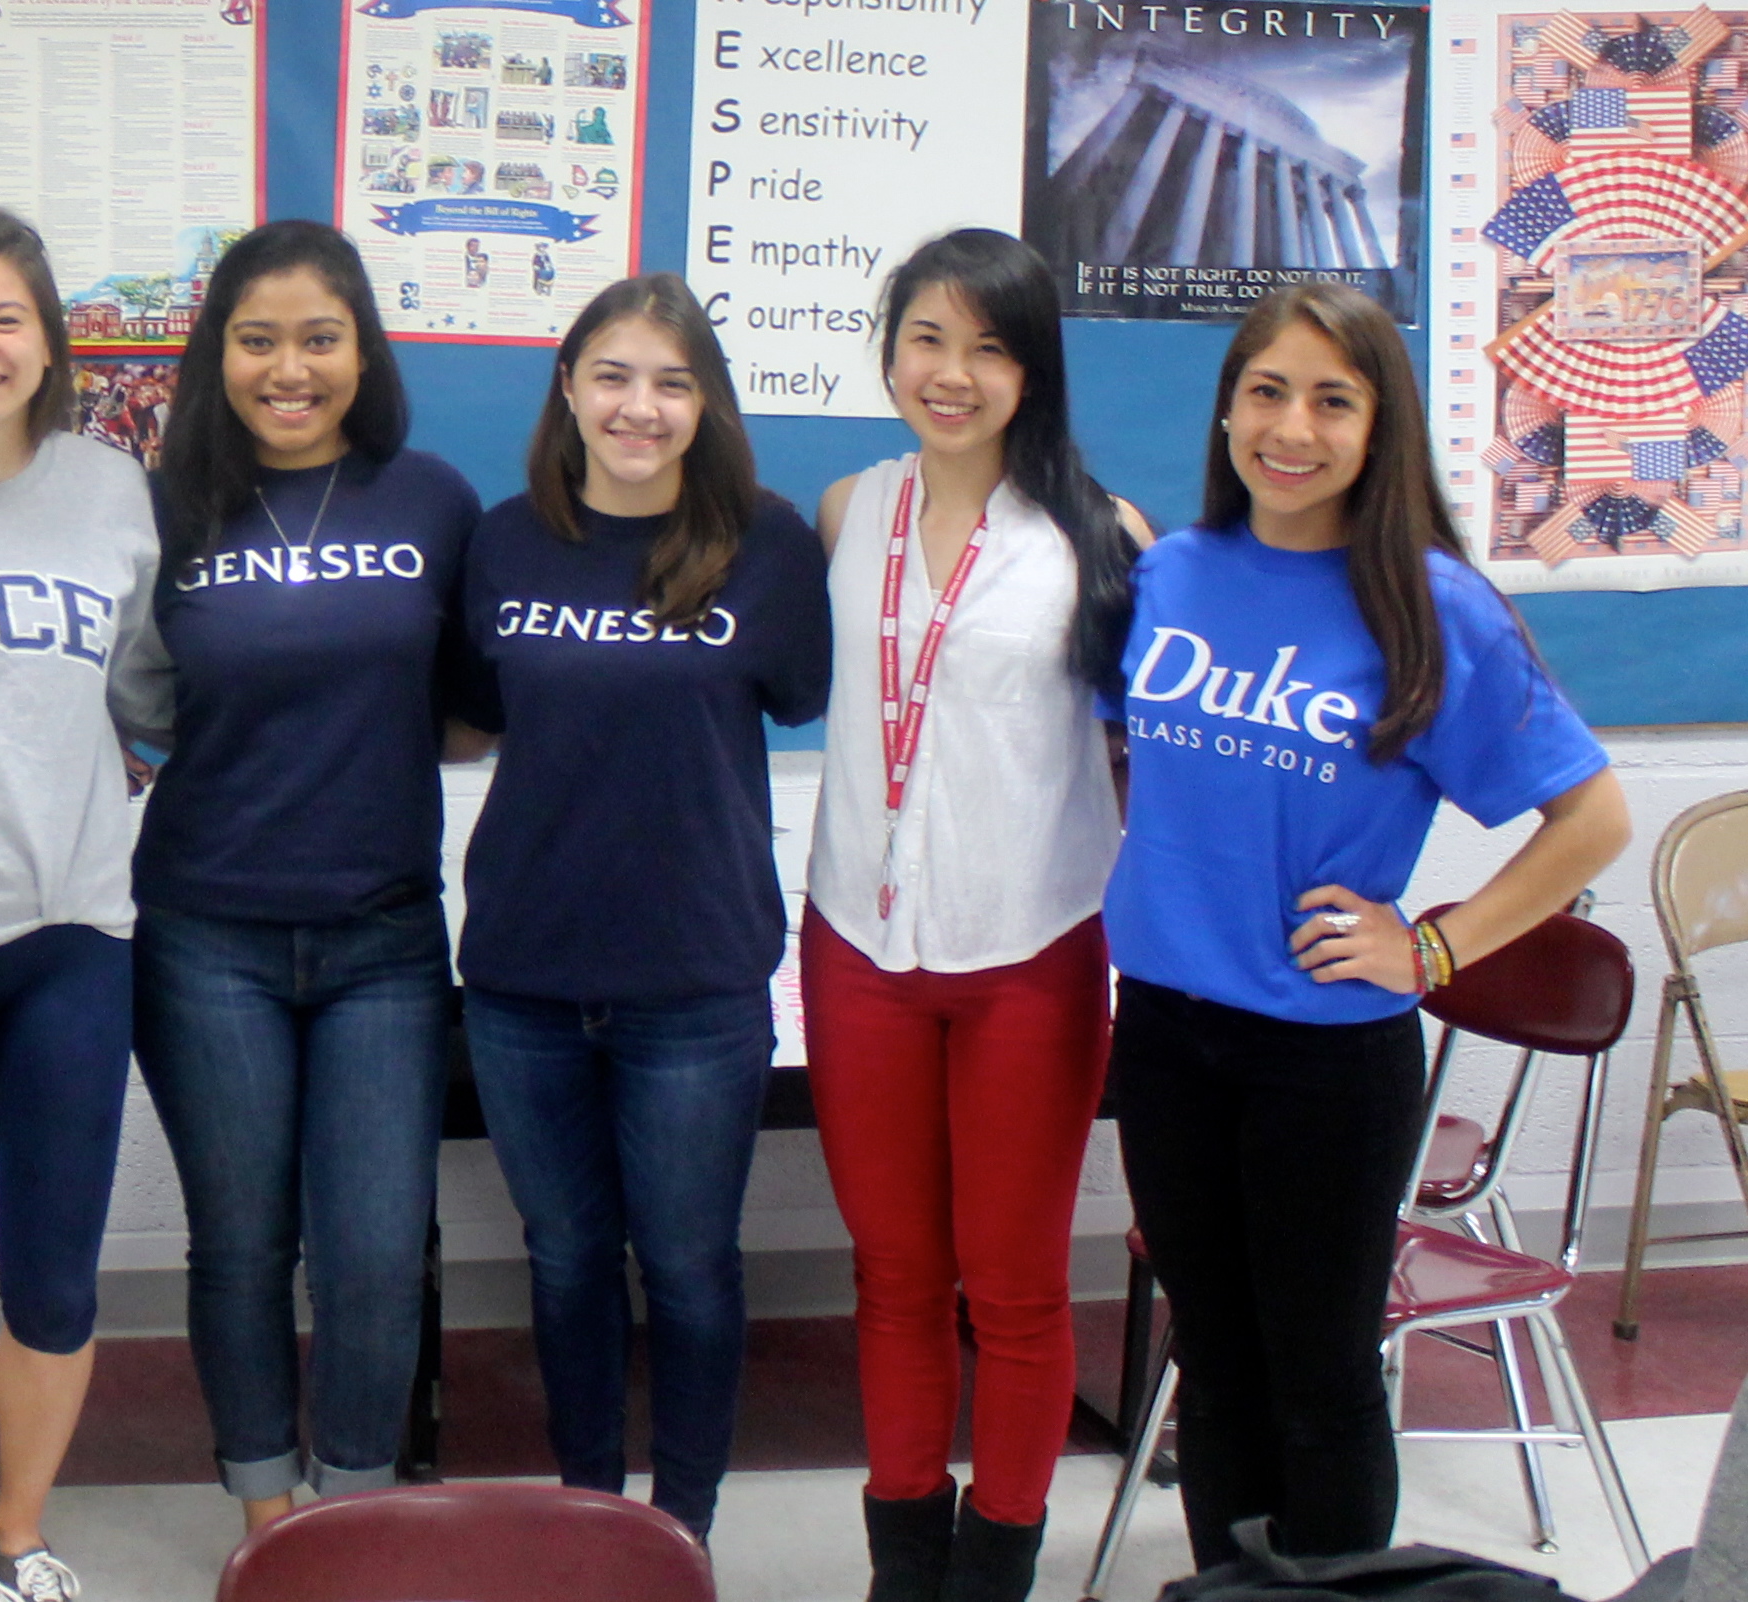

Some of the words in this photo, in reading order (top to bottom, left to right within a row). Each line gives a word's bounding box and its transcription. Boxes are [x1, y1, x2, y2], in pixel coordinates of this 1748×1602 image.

[1067, 3, 1396, 40] INTEGRITY
[1099, 266, 1117, 279] IT
[1123, 266, 1140, 280] IS
[1143, 267, 1180, 281] NOT
[1247, 270, 1272, 283] DO
[1276, 270, 1312, 284] NOT
[1099, 282, 1117, 295] IT
[1123, 282, 1139, 296] IS
[1143, 283, 1180, 297] NOT
[1238, 285, 1263, 298] DO
[1128, 714, 1202, 750] CLASS
[1214, 734, 1253, 759] OF
[1262, 744, 1337, 784] 2018
